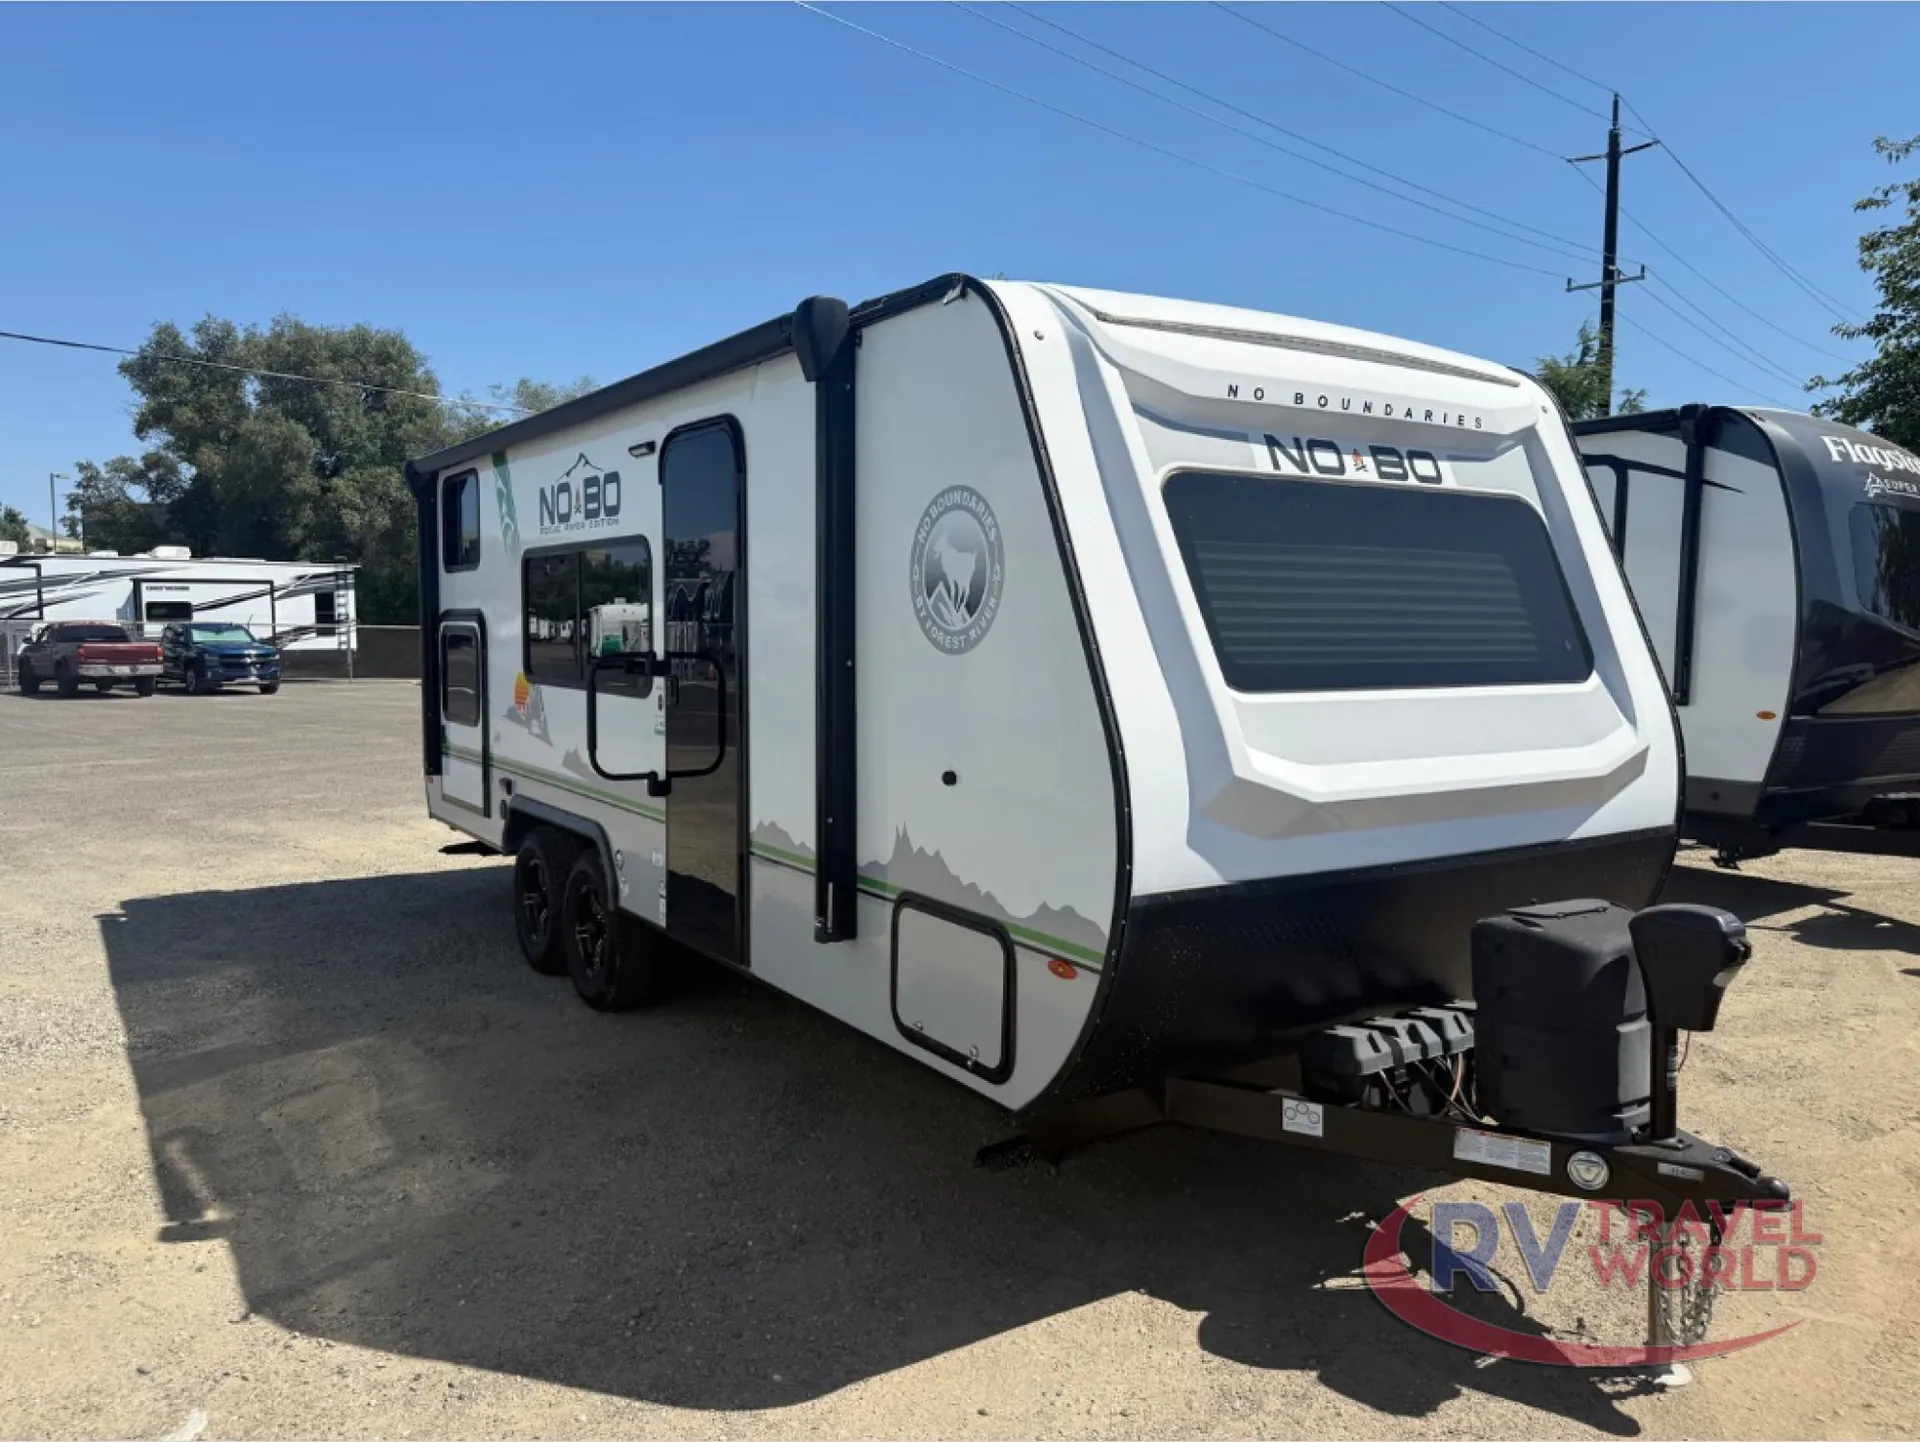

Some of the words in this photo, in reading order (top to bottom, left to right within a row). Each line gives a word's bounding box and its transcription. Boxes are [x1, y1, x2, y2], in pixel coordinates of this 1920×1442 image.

[1226, 383, 1266, 401] NO
[1293, 391, 1484, 430] BOUNDARIES
[1263, 433, 1347, 476] NO
[539, 481, 572, 526] NO
[917, 516, 933, 545] NO
[930, 490, 998, 542] BOUNDARIES
[915, 596, 928, 617] BY
[925, 620, 967, 650] FOREST
[968, 597, 998, 641] RIVER
